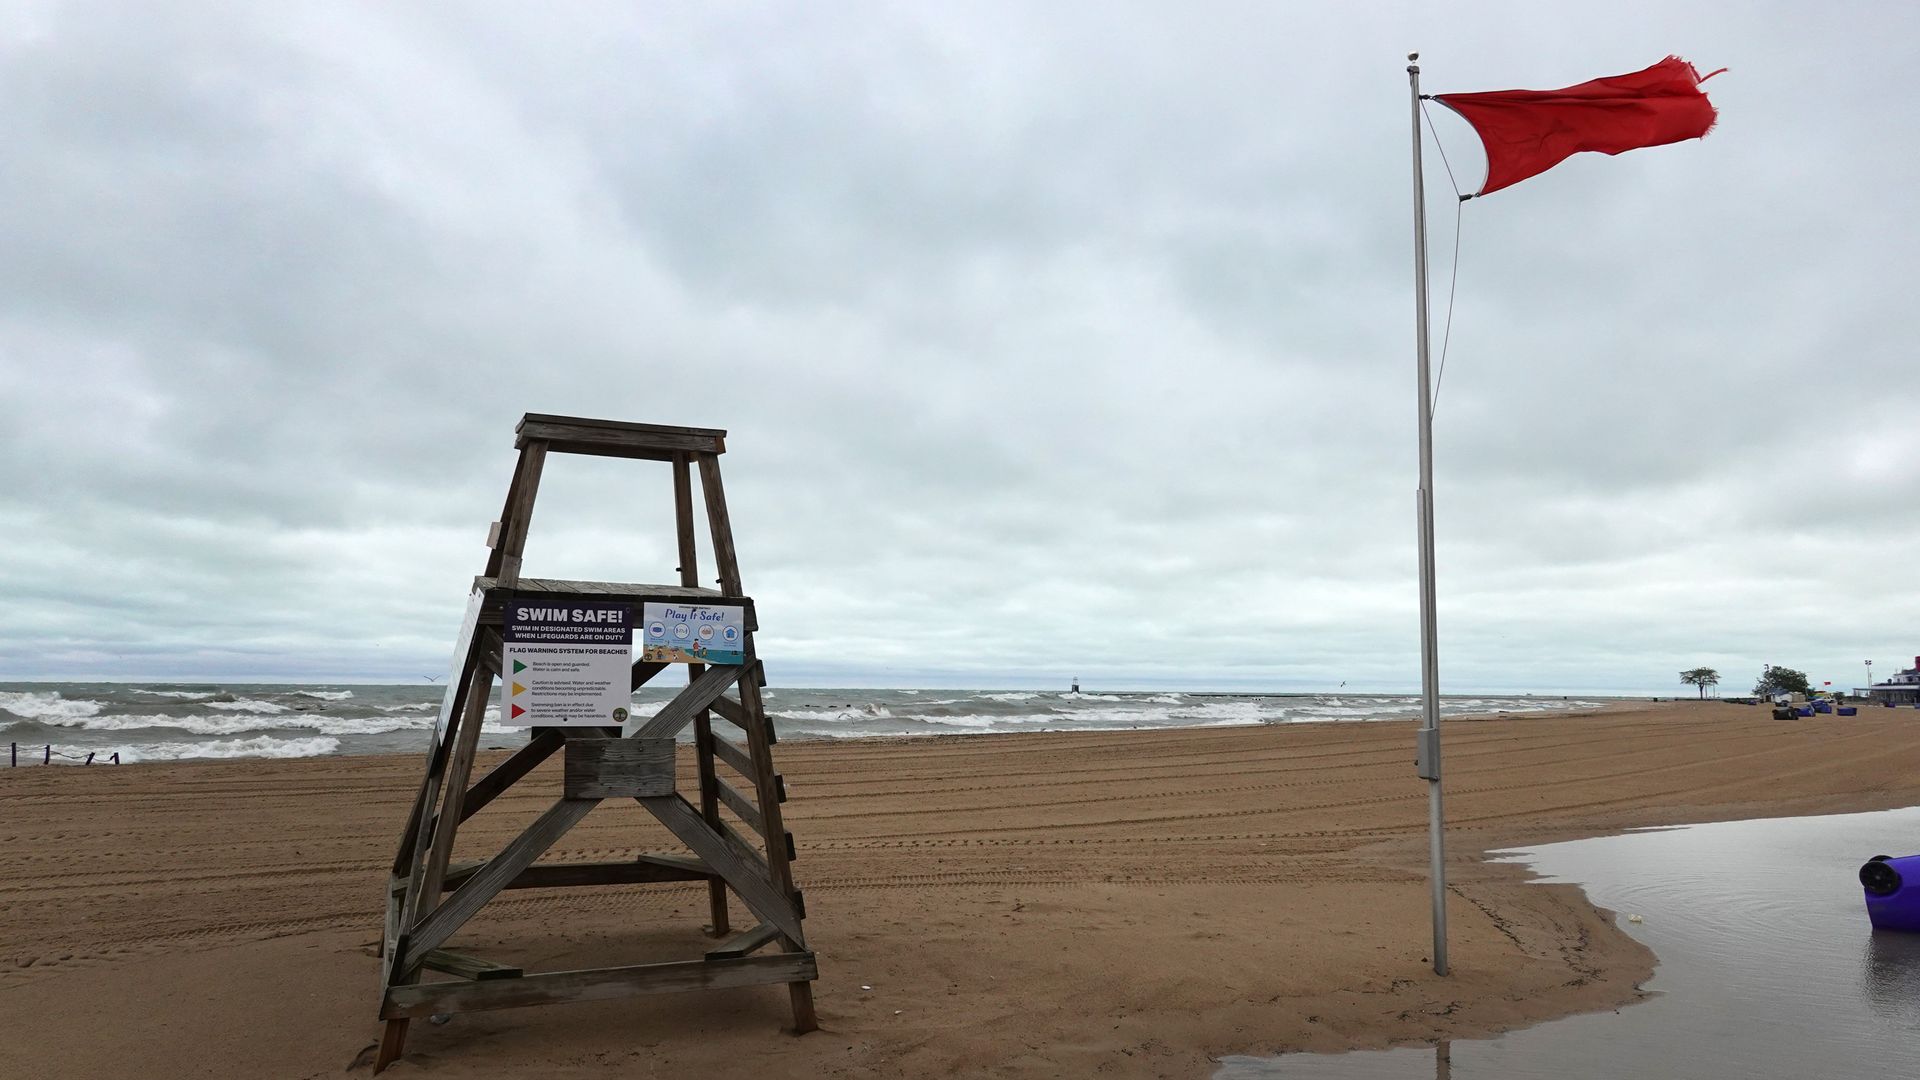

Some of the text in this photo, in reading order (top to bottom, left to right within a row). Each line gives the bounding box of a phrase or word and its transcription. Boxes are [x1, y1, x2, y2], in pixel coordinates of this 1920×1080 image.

[517, 607, 623, 623] SWIM SAFE!
[665, 608, 724, 622] Play It Safe!
